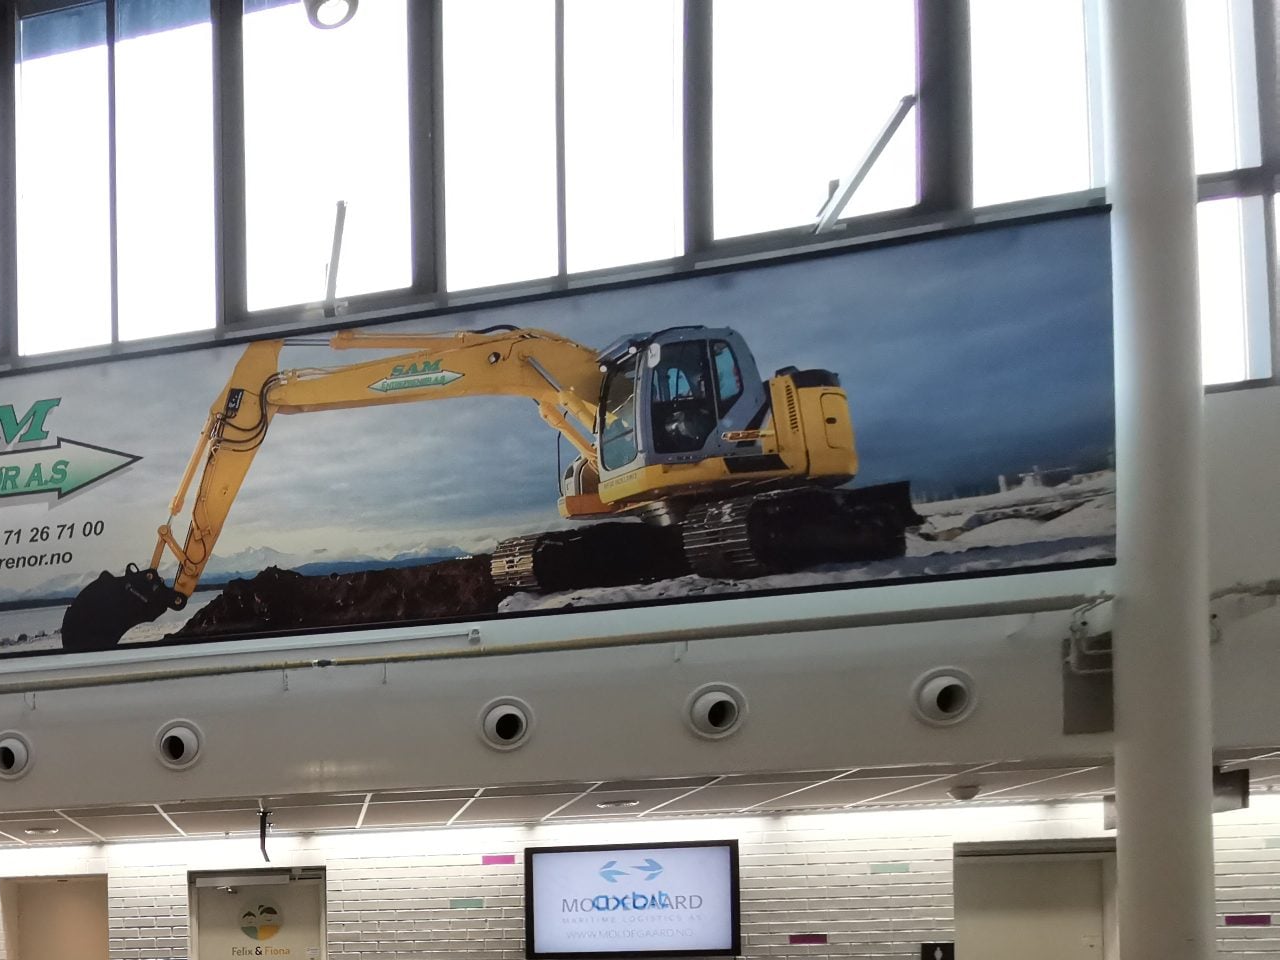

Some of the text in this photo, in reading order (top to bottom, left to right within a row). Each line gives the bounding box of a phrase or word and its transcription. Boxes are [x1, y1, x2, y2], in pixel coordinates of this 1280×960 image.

[390, 359, 444, 377] SAM
[24, 459, 70, 488] A.S
[3, 528, 22, 546] 71
[29, 526, 50, 543] 26
[56, 522, 75, 540] 71
[82, 520, 105, 537] 00
[231, 946, 290, 956] Felix & Fiona
